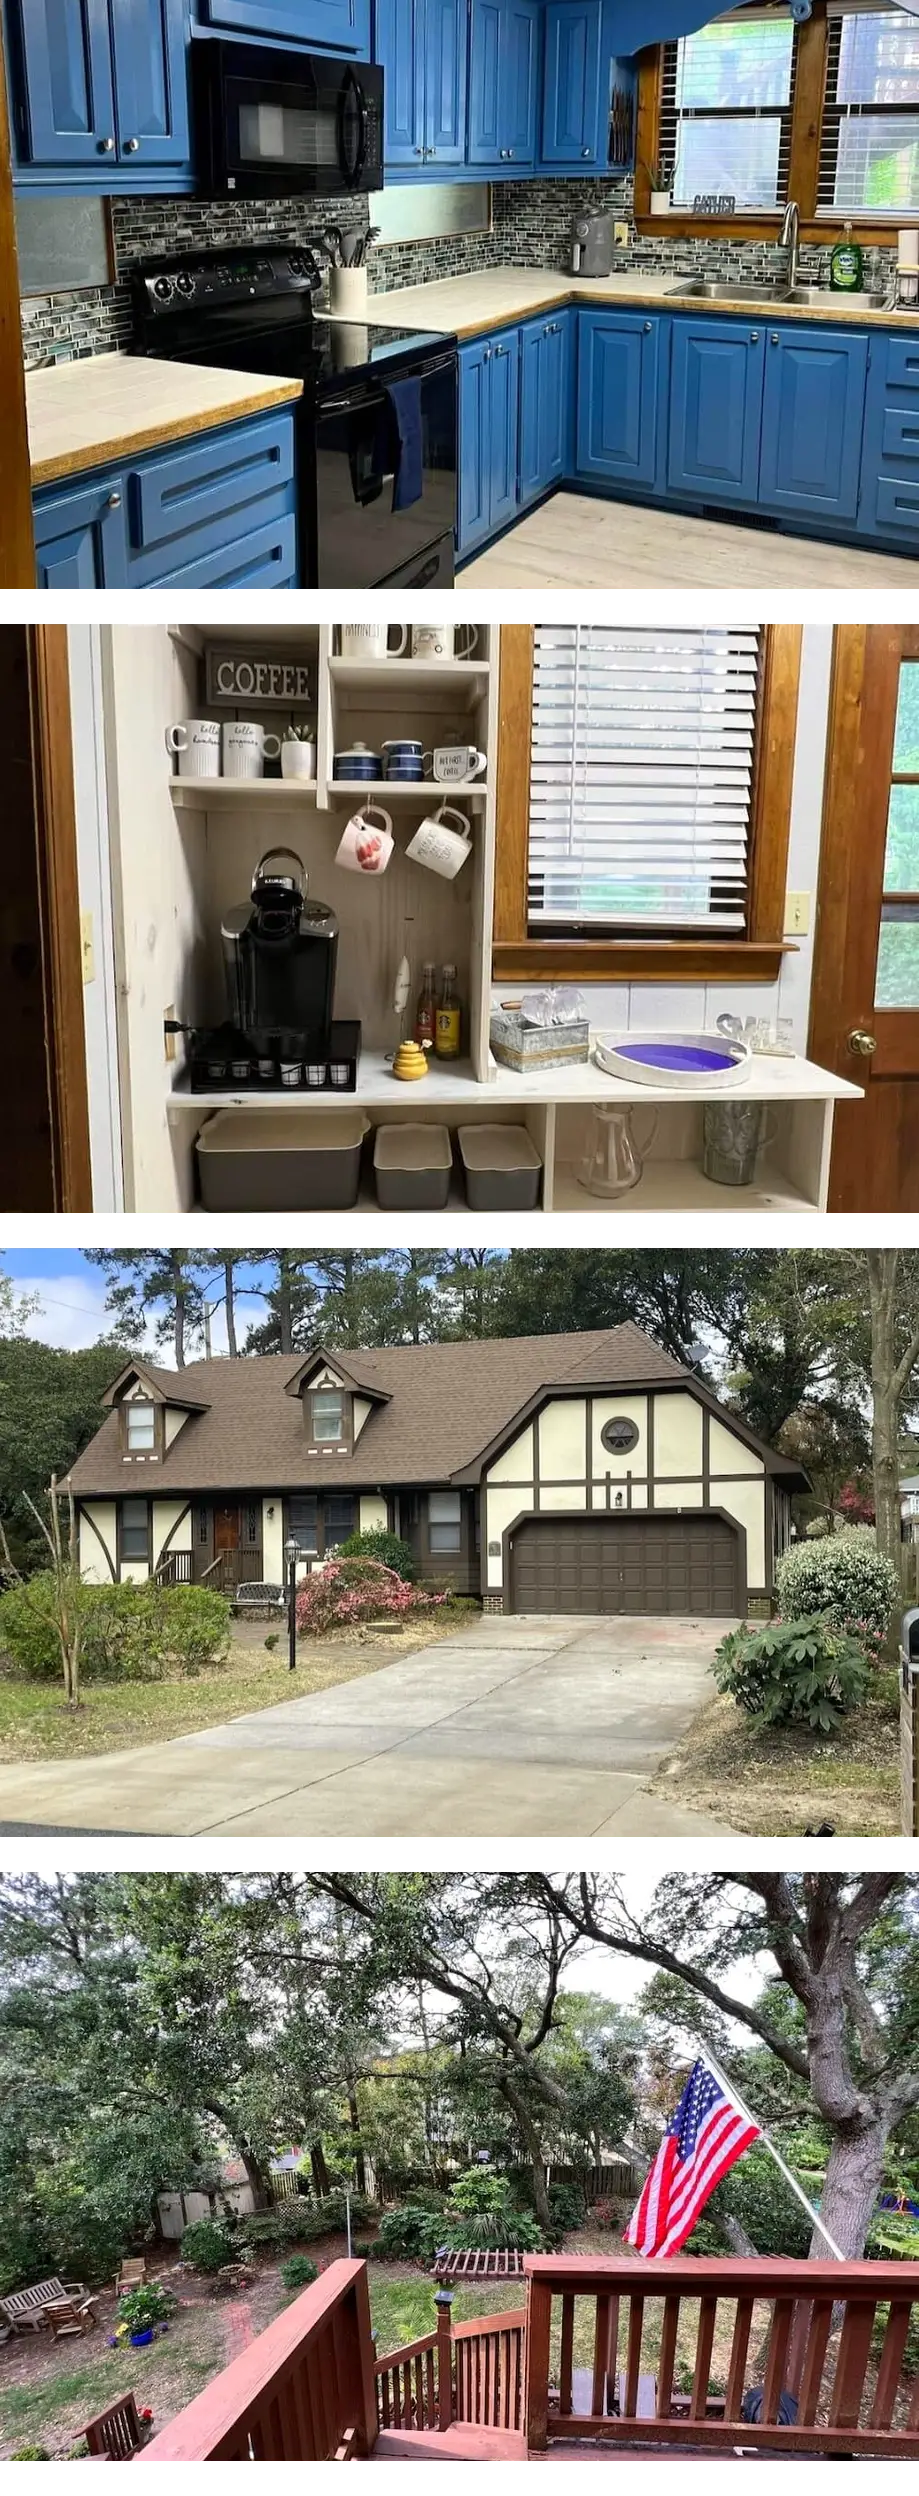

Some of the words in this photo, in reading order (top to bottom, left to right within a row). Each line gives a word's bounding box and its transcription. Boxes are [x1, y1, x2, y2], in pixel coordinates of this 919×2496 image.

[217, 661, 309, 698] COFFEE
[200, 724, 220, 735] hello
[234, 725, 255, 735] hello
